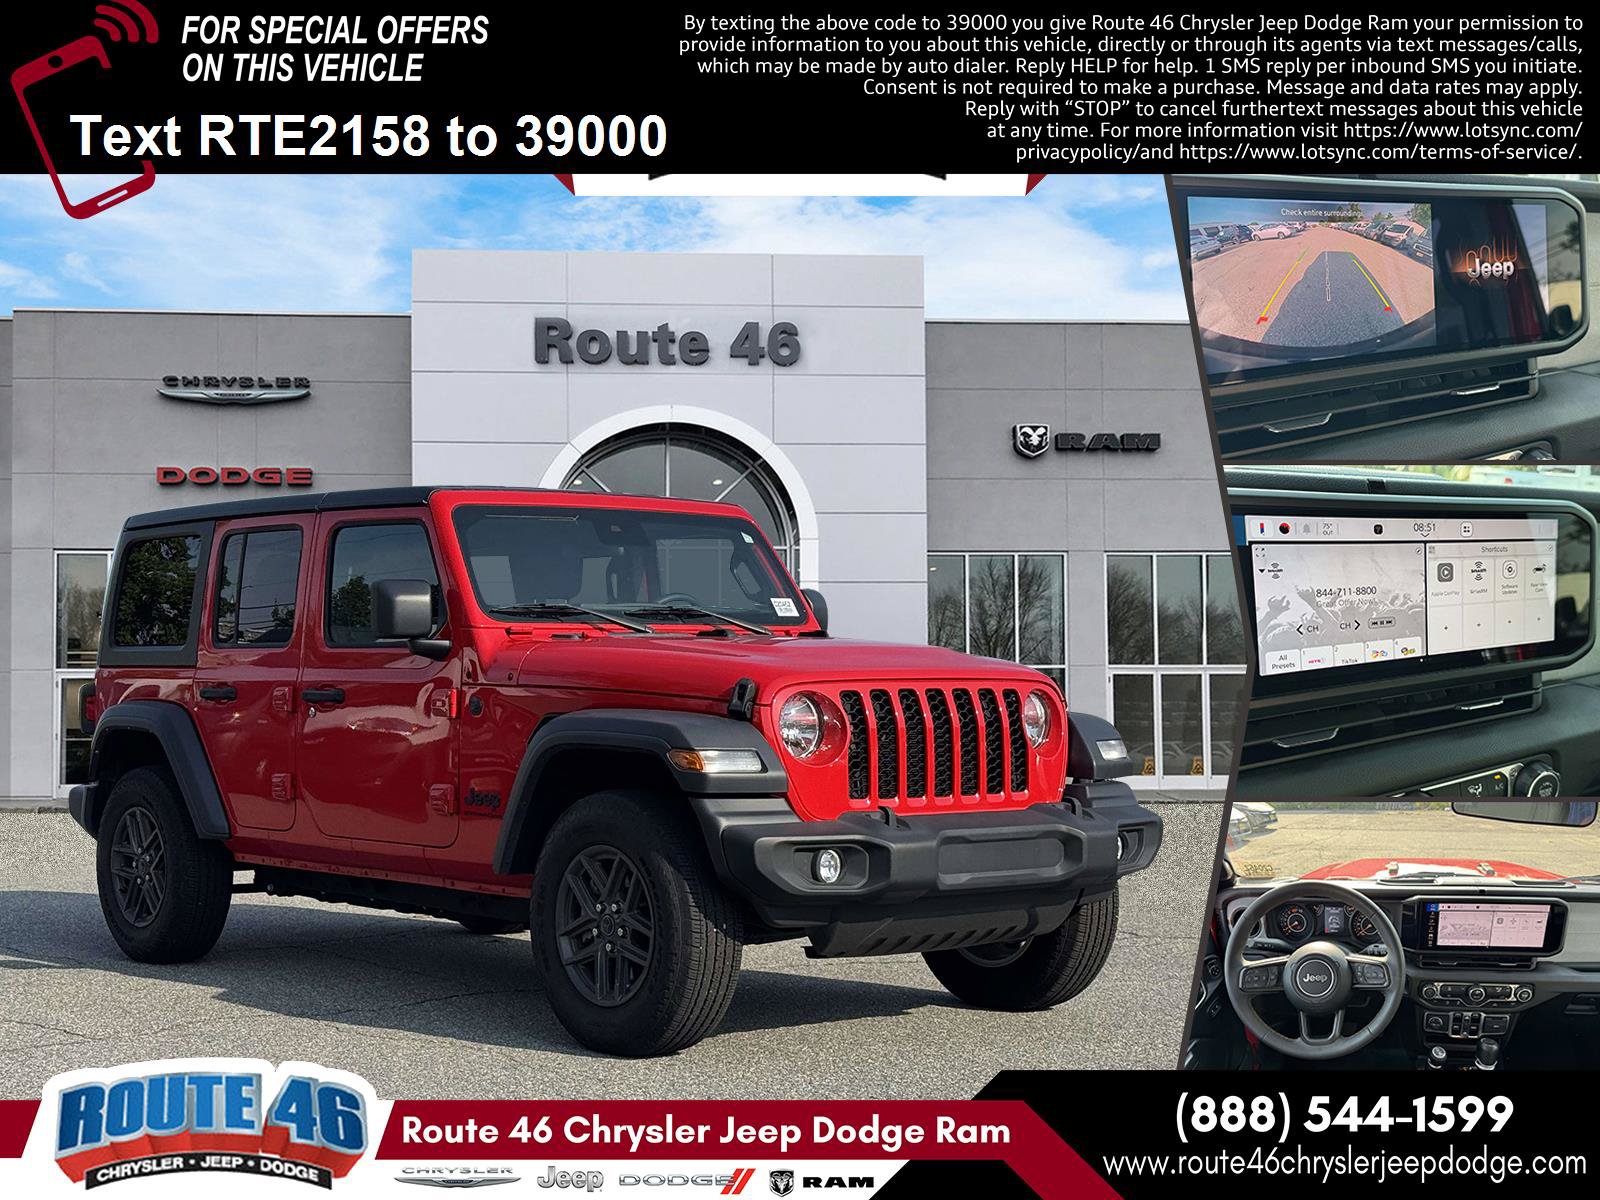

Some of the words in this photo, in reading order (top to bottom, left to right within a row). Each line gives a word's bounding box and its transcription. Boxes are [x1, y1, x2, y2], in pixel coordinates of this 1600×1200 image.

[1281, 207, 1303, 217] Check
[1303, 208, 1323, 217] entire
[1467, 257, 1515, 280] Jeep
[534, 316, 710, 366] Route
[729, 321, 801, 367] 46
[162, 375, 311, 388] CHRYSLER
[1054, 432, 1161, 452] RAM
[156, 466, 313, 486] DODGE
[1413, 522, 1436, 533] 08:51
[1481, 545, 1509, 553] Shortcuts
[1315, 586, 1377, 598] 844-711-8800
[1307, 625, 1319, 633] CH
[1340, 622, 1351, 630] CH
[1271, 661, 1296, 670] Presets
[464, 787, 501, 810] Jeep
[1303, 973, 1328, 983] Jeep
